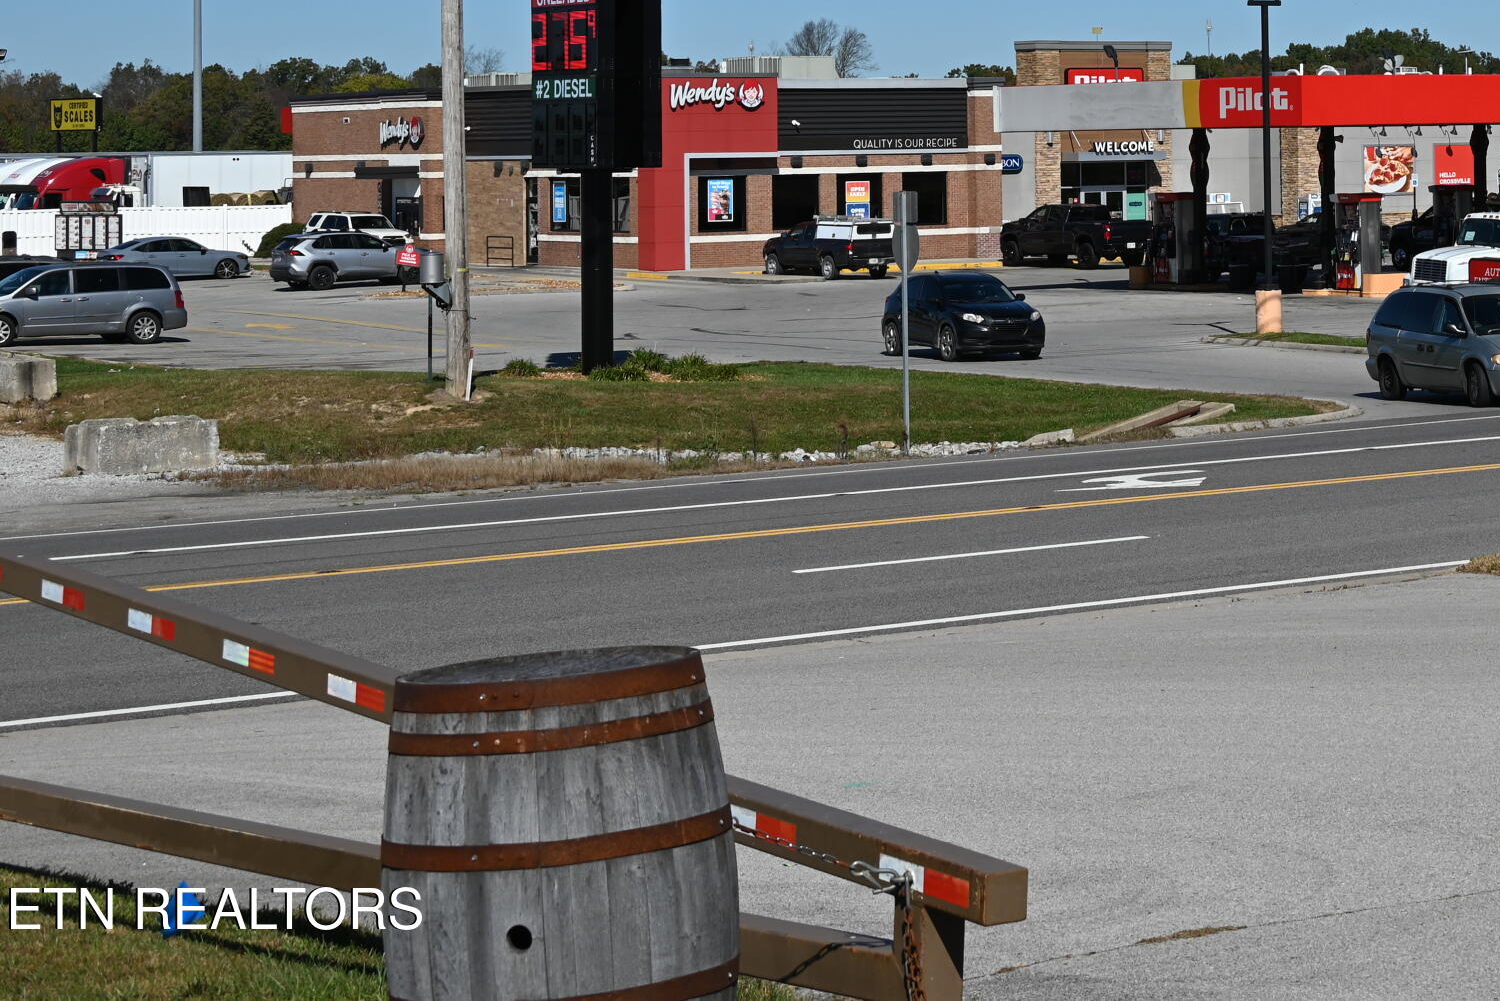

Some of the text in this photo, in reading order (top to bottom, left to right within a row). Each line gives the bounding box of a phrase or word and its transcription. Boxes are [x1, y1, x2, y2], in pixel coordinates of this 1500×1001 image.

[535, 78, 593, 100] #2 DIESEL
[669, 78, 736, 109] Wendy's
[68, 102, 89, 110] CERTIFIED
[64, 110, 94, 123] SCALES
[379, 116, 409, 145] Wendy's
[853, 137, 958, 149] QUALITY IS OUR RECIPE
[1095, 141, 1155, 153] WELCOME
